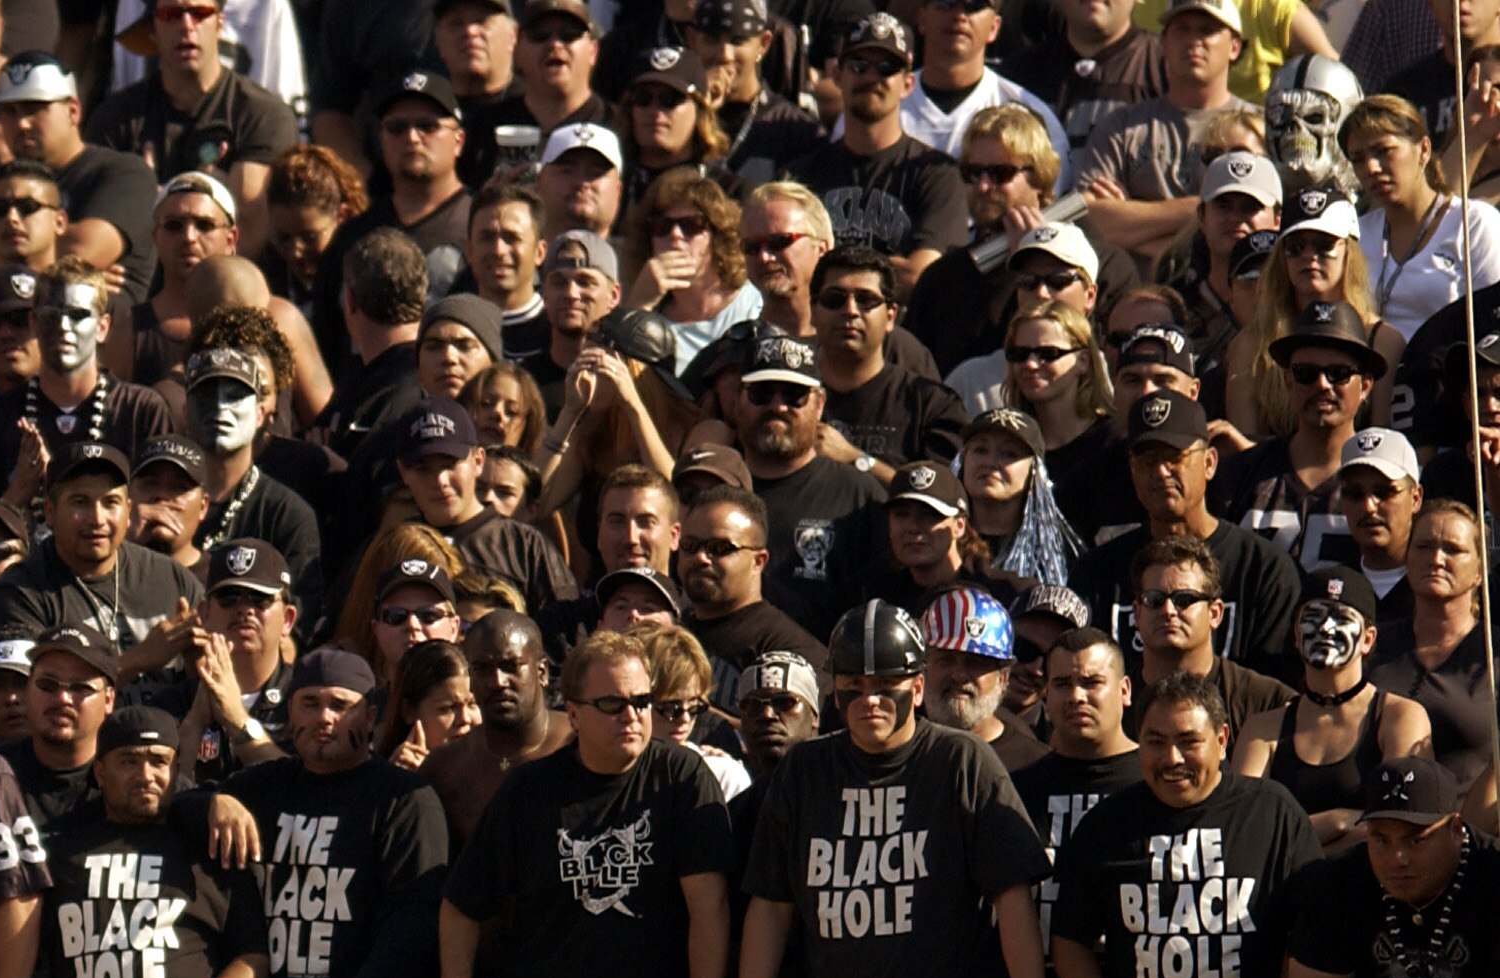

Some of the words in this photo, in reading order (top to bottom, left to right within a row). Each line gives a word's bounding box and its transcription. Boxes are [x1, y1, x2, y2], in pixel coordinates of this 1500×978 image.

[842, 785, 906, 838] THE
[272, 812, 339, 866] THE
[560, 842, 654, 882] BLCK
[807, 830, 929, 888] BLACK
[1149, 828, 1225, 881] THE
[84, 853, 163, 899] THE
[573, 864, 639, 900] HLE
[58, 898, 187, 958] BLACK
[818, 885, 914, 938] HOLE
[1120, 878, 1257, 935] BLACK
[268, 917, 334, 975] OLE
